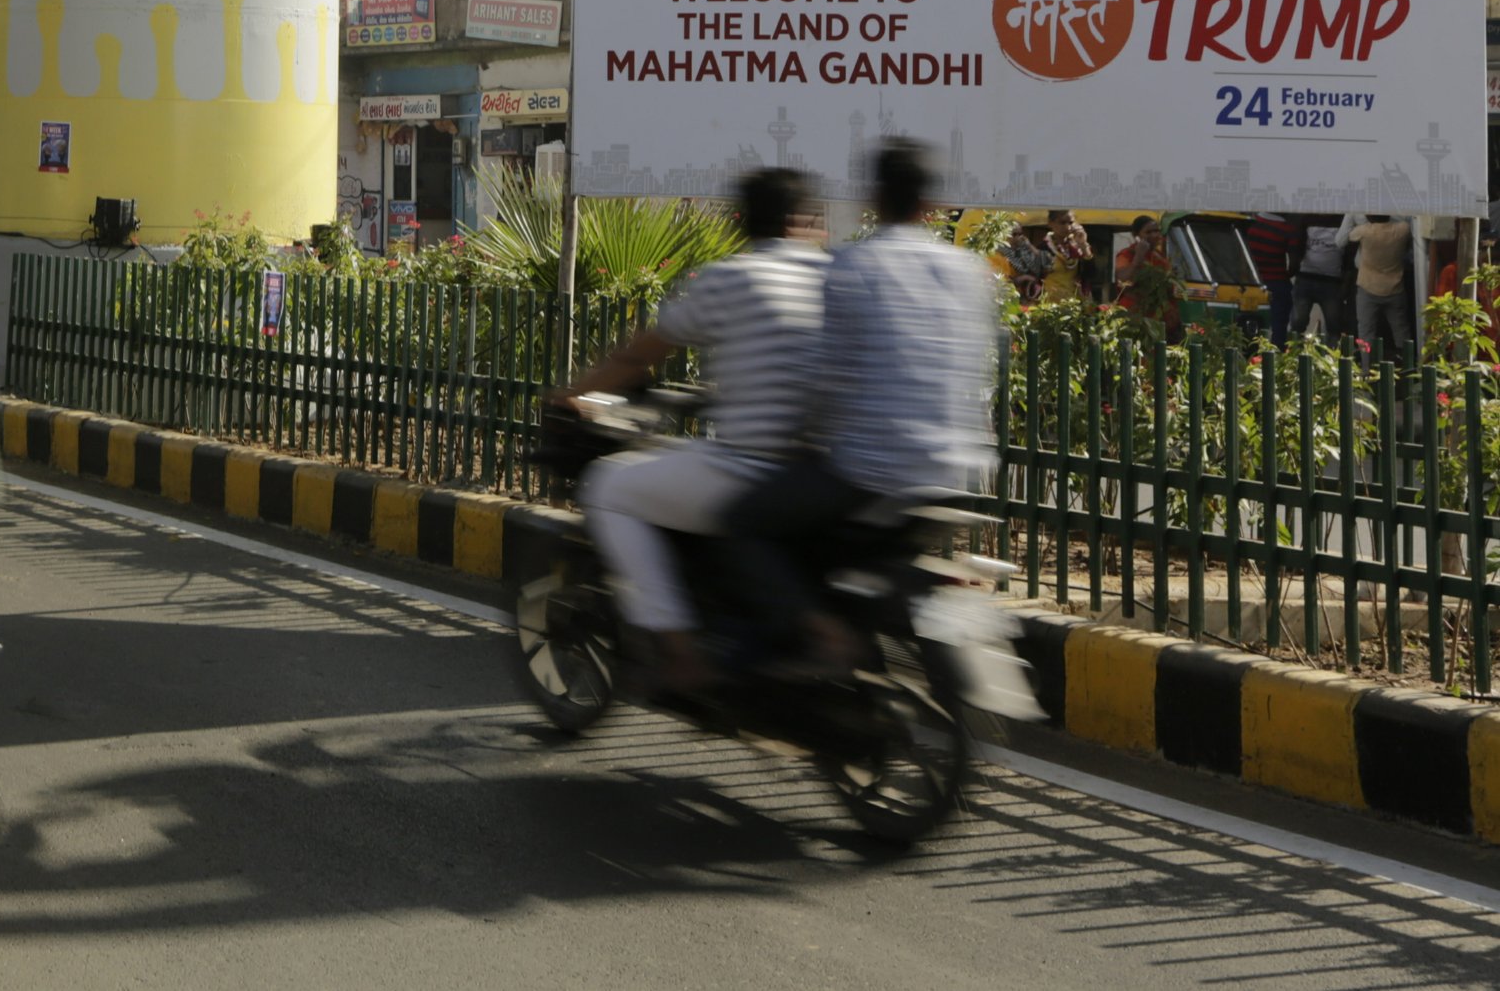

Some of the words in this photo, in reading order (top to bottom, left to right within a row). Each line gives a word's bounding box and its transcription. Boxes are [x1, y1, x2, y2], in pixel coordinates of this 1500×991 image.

[474, 2, 517, 21] ARIHANT
[520, 7, 553, 25] SALES
[677, 12, 743, 40] THE
[753, 12, 849, 42] LAND
[859, 13, 909, 42] OF
[606, 50, 808, 83] MAHATMA
[818, 51, 983, 86] GANDHI
[1214, 85, 1273, 127] 24
[1281, 87, 1375, 111] February
[1281, 109, 1336, 128] 2020
